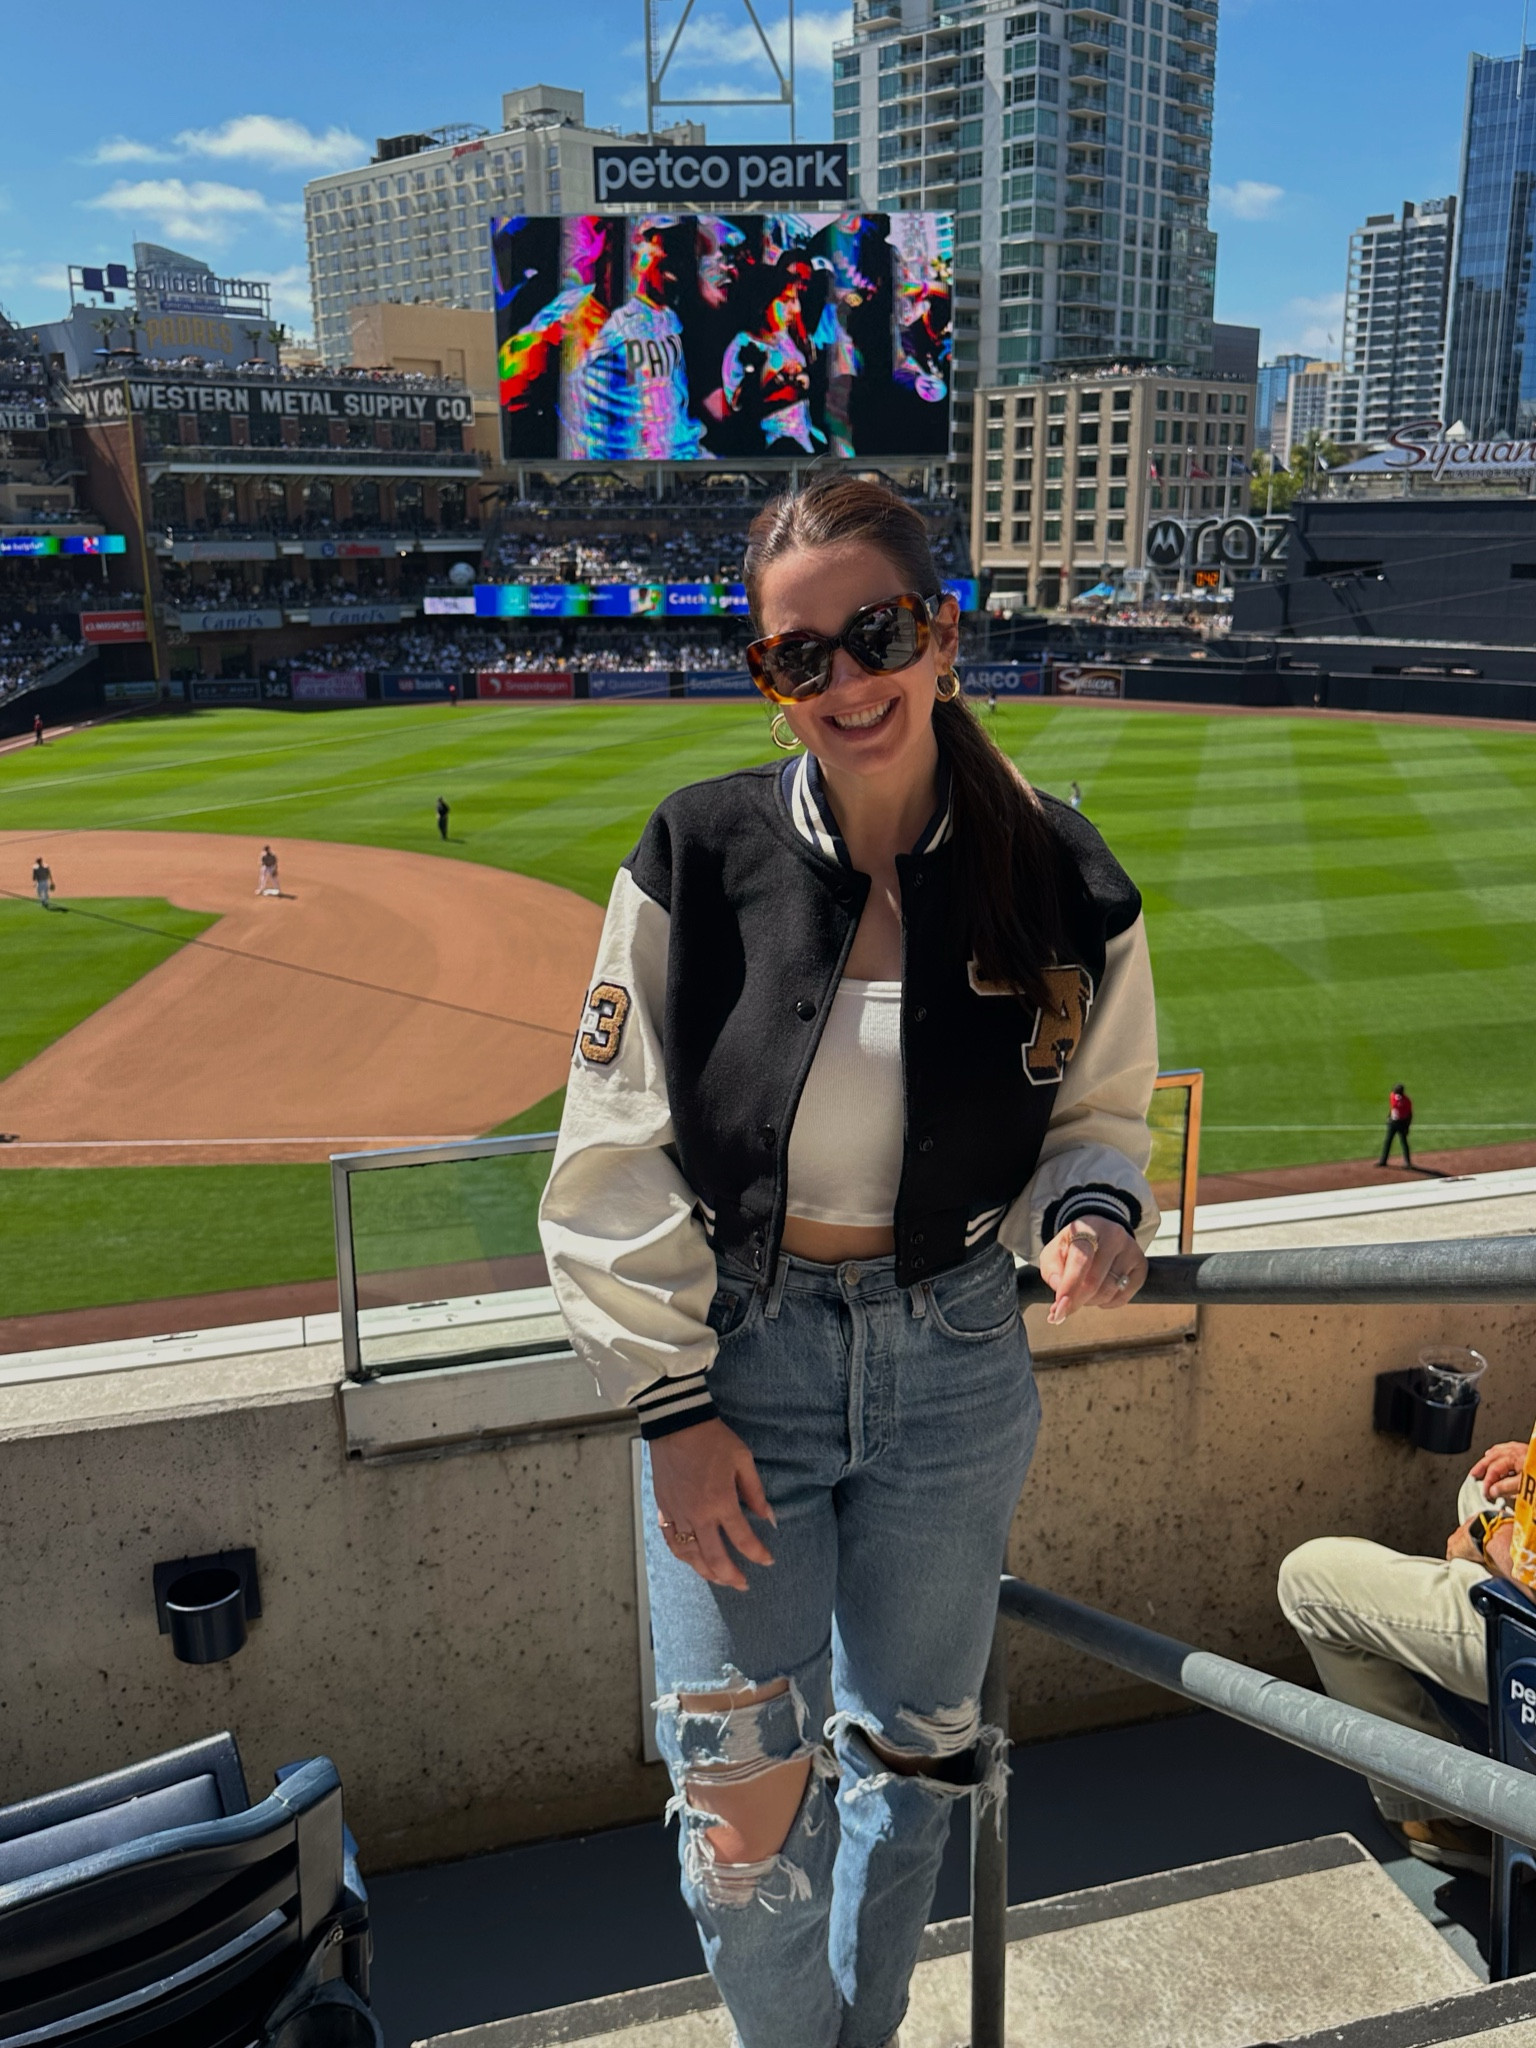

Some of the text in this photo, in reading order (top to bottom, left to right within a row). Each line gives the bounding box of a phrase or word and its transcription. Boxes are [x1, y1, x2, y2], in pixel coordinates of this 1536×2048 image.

[598, 149, 843, 200] petco park
[146, 317, 233, 354] PADRES
[129, 383, 473, 422] WESTERN METAL SUPPLY CO.
[668, 592, 708, 605] Catch
[202, 613, 263, 630] Canel's
[328, 608, 385, 624] Canel's
[965, 671, 1021, 689] ARCO
[1521, 1702, 1536, 1724] p
